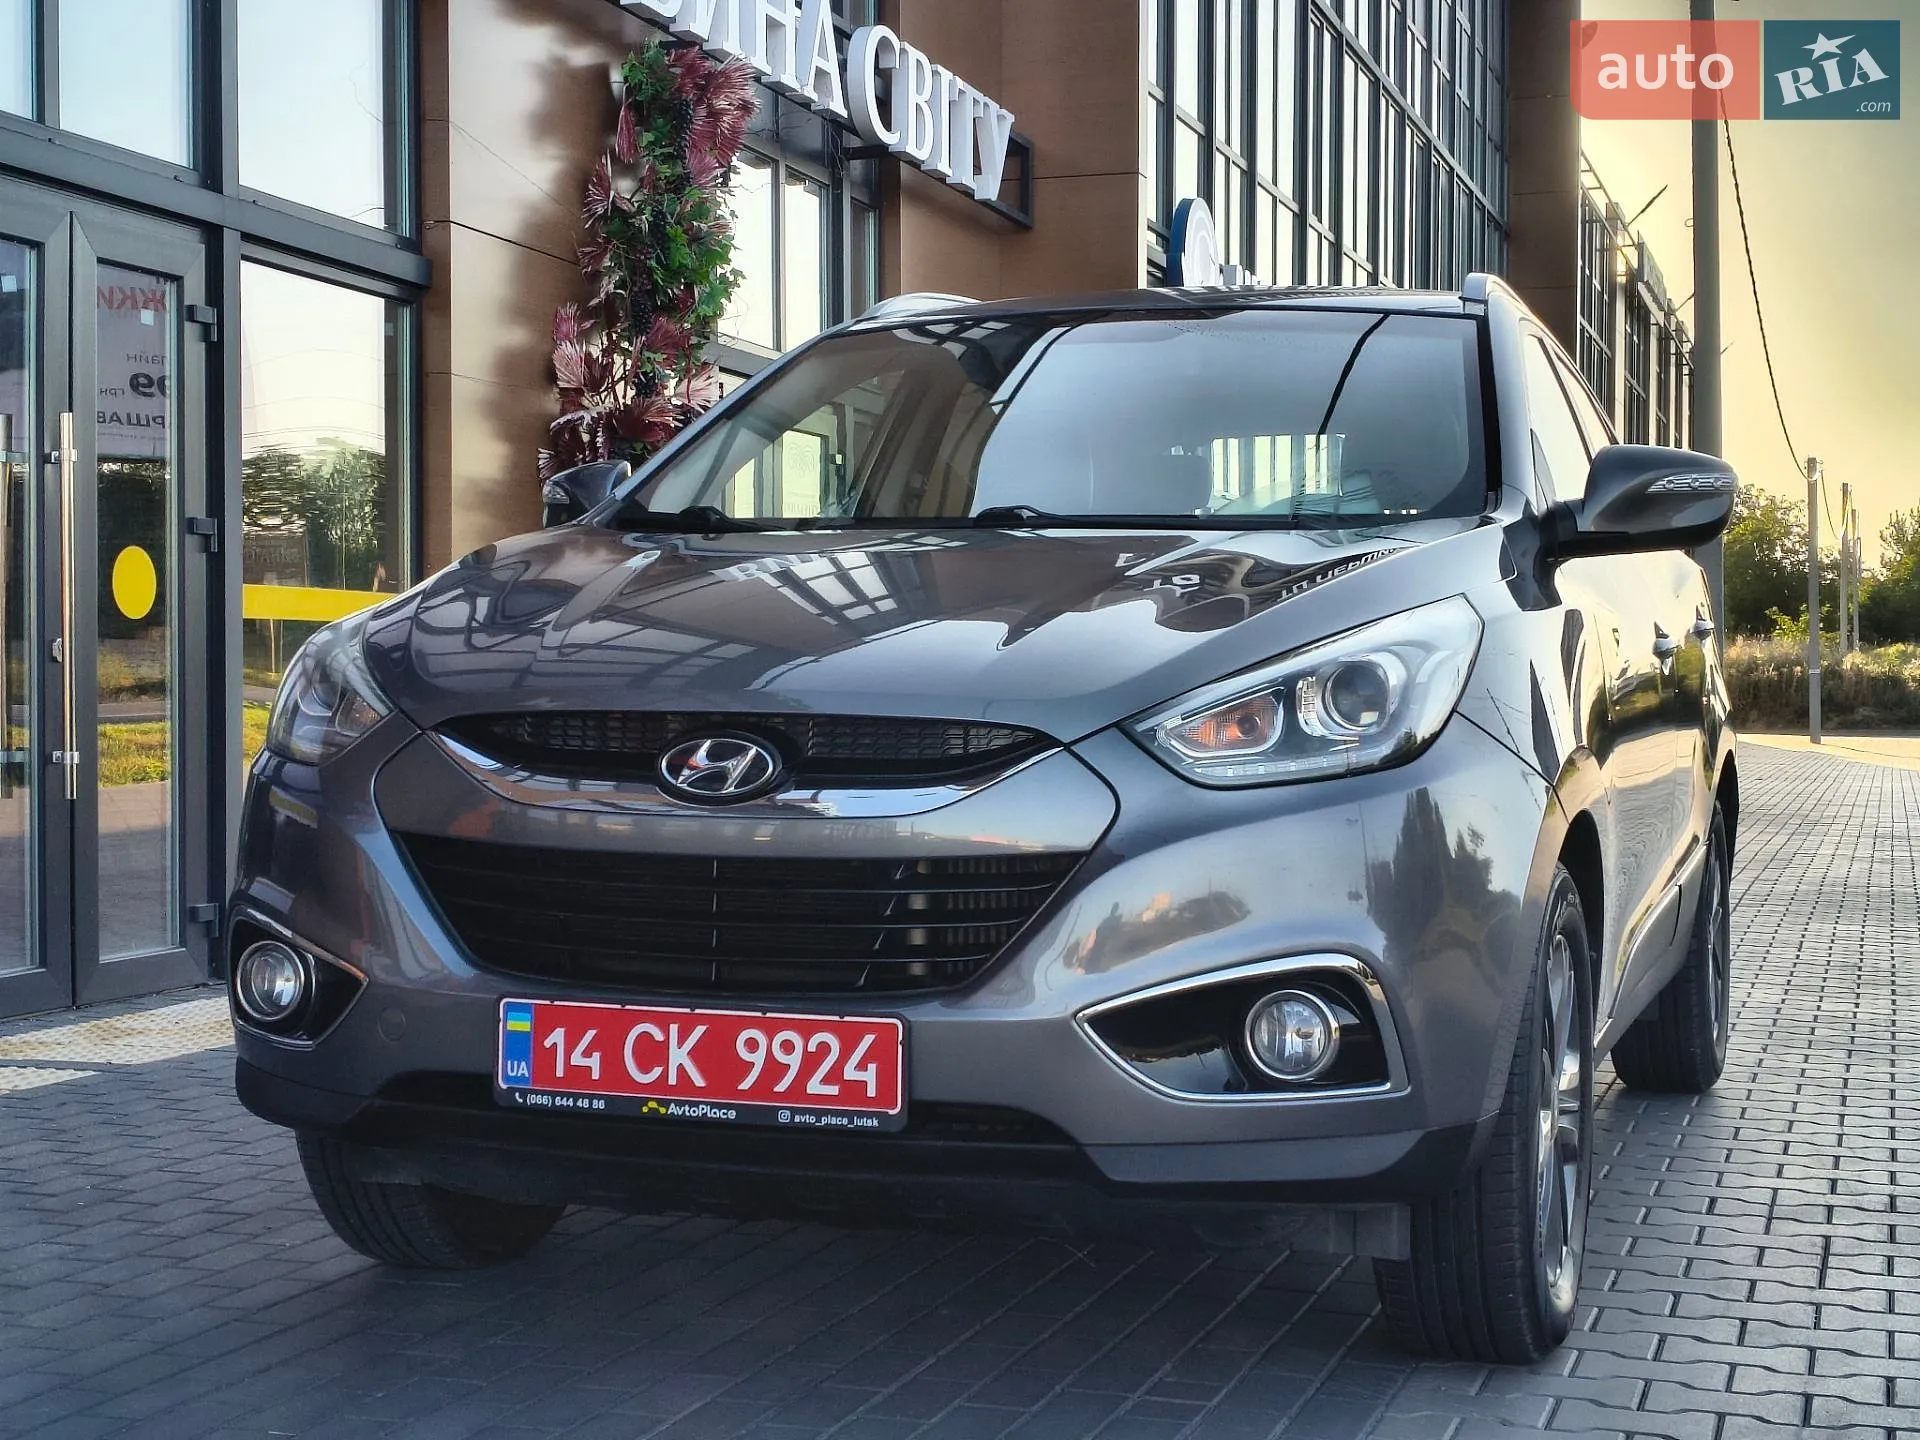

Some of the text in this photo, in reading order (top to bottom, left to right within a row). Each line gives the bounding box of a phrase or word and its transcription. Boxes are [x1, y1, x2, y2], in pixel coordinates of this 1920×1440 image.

[507, 1060, 529, 1078] UA
[543, 1023, 878, 1098] 14 CK 9924
[667, 1102, 737, 1120] AvtoPlace
